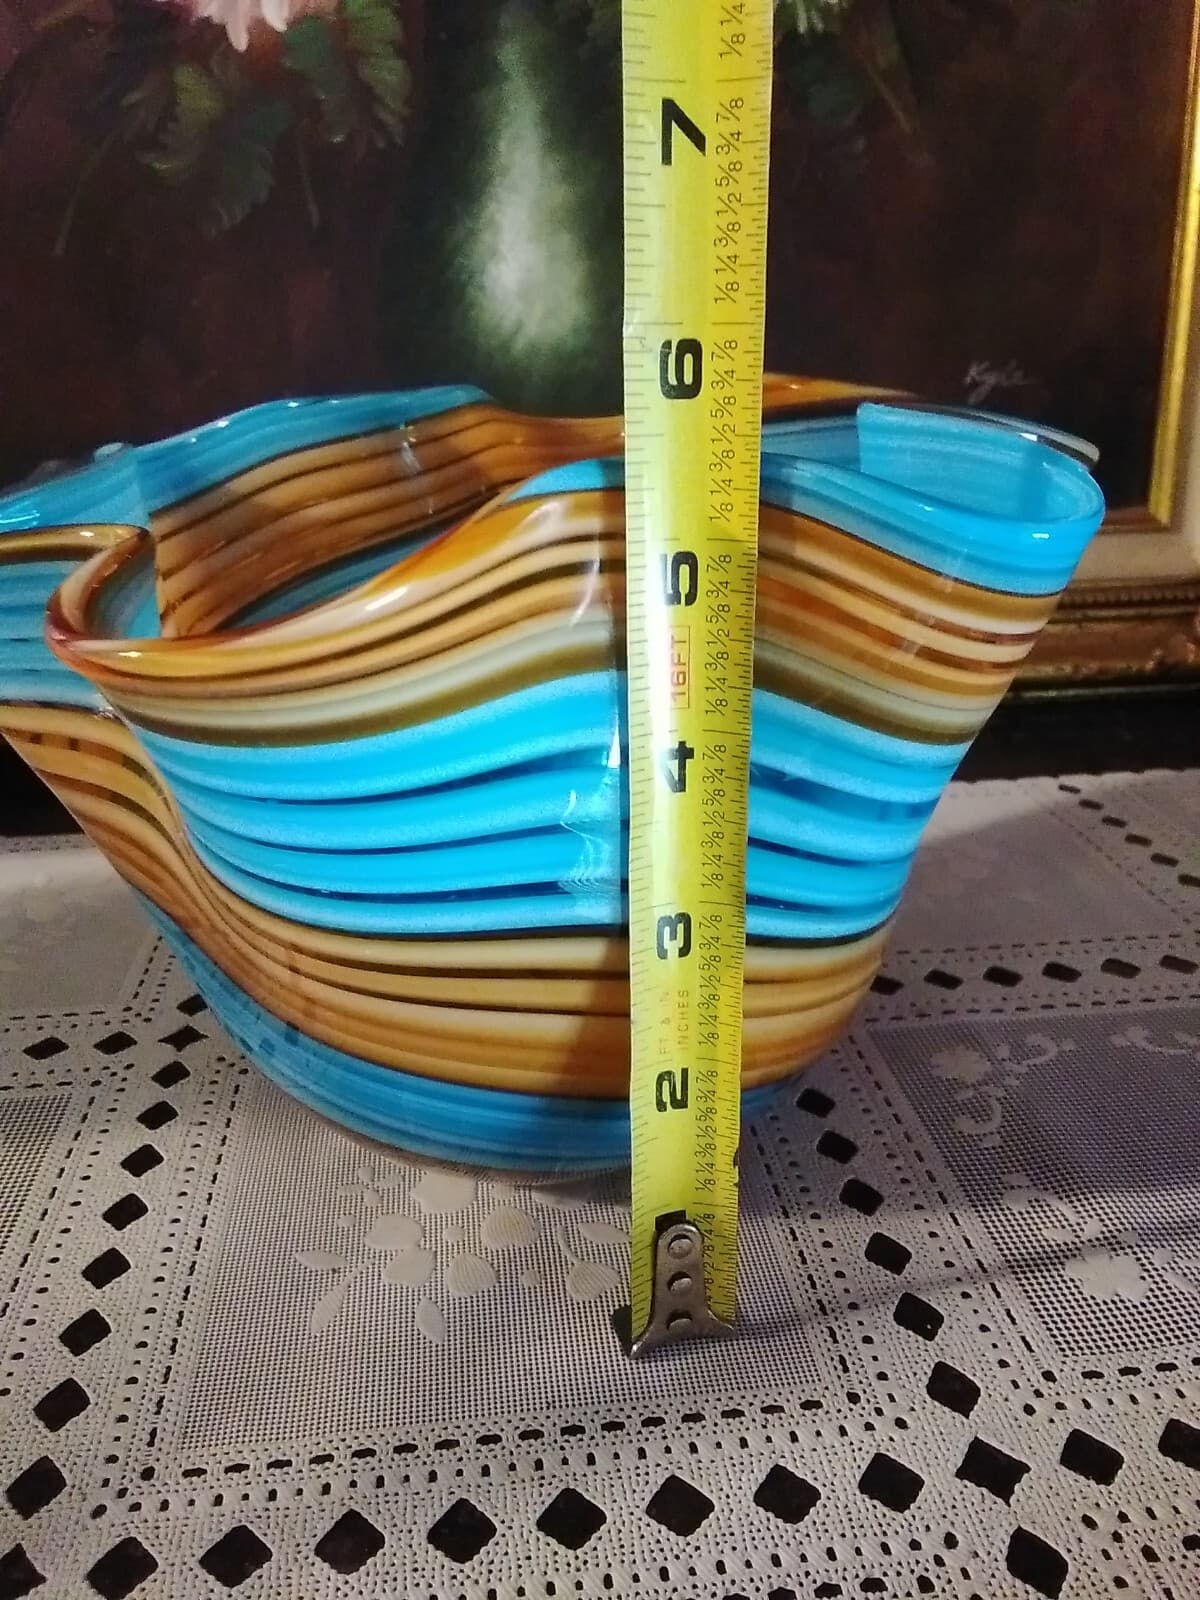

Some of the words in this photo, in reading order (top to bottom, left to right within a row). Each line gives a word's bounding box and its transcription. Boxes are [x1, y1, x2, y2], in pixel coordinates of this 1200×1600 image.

[720, 2, 746, 26] 1/4
[719, 33, 746, 59] 1/8
[715, 97, 744, 122] 7/8
[661, 97, 706, 166] 7
[715, 130, 743, 155] 3/4
[714, 161, 743, 187] 5/8
[716, 192, 742, 217] 1/2
[713, 221, 741, 248] 3/8
[715, 254, 740, 275] 1/4
[714, 281, 740, 304] 1/8
[710, 339, 738, 361] 7/8
[659, 338, 703, 399] 6
[710, 369, 736, 390] 3/4
[710, 395, 737, 419] 5/8
[711, 424, 736, 445] 1/2
[709, 449, 735, 472] 3/8
[710, 478, 734, 496] 1/4
[709, 502, 734, 522] 1/8
[706, 554, 732, 574] 7/8
[660, 551, 699, 607] 5
[706, 580, 730, 598] 3/4
[706, 603, 730, 624] 5/8
[706, 628, 730, 648] 1/2
[705, 651, 729, 671] 3/8
[705, 675, 728, 693] 1/4
[705, 698, 728, 717] 1/8
[702, 744, 727, 762] 7/8
[662, 740, 695, 793] 4
[702, 767, 726, 784] 3/4
[701, 788, 726, 806] 5/8
[703, 810, 725, 828] 1/2
[701, 831, 725, 848] 3/8
[702, 853, 724, 869] 1/4
[701, 873, 724, 889] 1/8
[699, 914, 722, 931] 7/8
[656, 912, 692, 960] 3
[699, 935, 721, 950] 3/4
[698, 954, 721, 971] 5/8
[699, 975, 721, 991] 1/2
[697, 993, 721, 1009] 3/8
[677, 990, 689, 1050] INCHES
[698, 1013, 720, 1028] 1/4
[698, 1032, 720, 1047] 1/8
[696, 1070, 718, 1086] 7/8
[656, 1067, 689, 1112] 2
[696, 1089, 717, 1103] 3/4
[695, 1107, 718, 1122] 5/8
[696, 1125, 717, 1140] 1/2
[695, 1143, 717, 1158] 3/8
[696, 1162, 716, 1175] 1/4
[695, 1178, 716, 1193] 1/8
